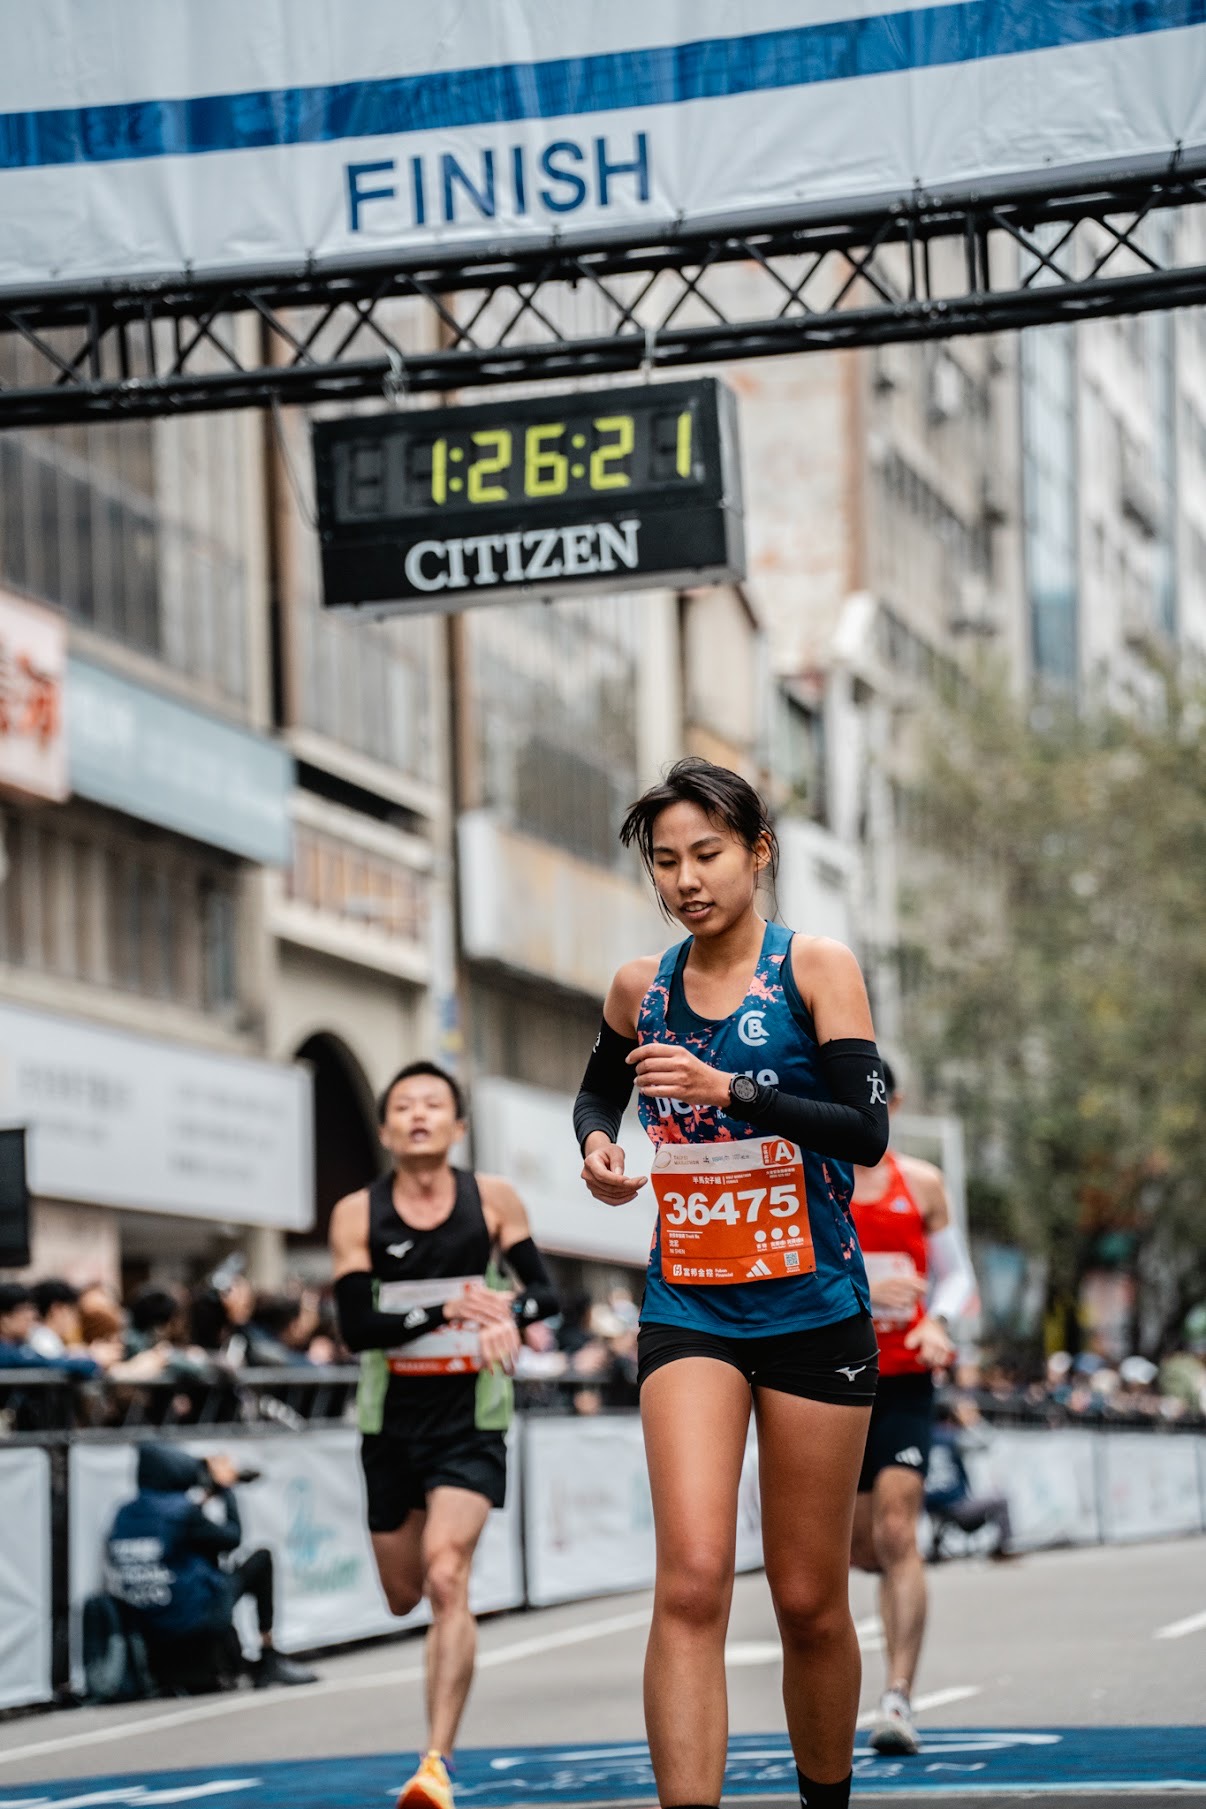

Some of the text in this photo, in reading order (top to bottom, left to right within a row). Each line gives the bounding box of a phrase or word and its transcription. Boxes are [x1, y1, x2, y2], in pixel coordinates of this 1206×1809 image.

[346, 131, 652, 232] FINISH
[431, 410, 692, 506] 1:26:21
[405, 520, 641, 592] CITIZEN
[774, 1141, 793, 1162] A
[663, 1184, 800, 1226] 36475
